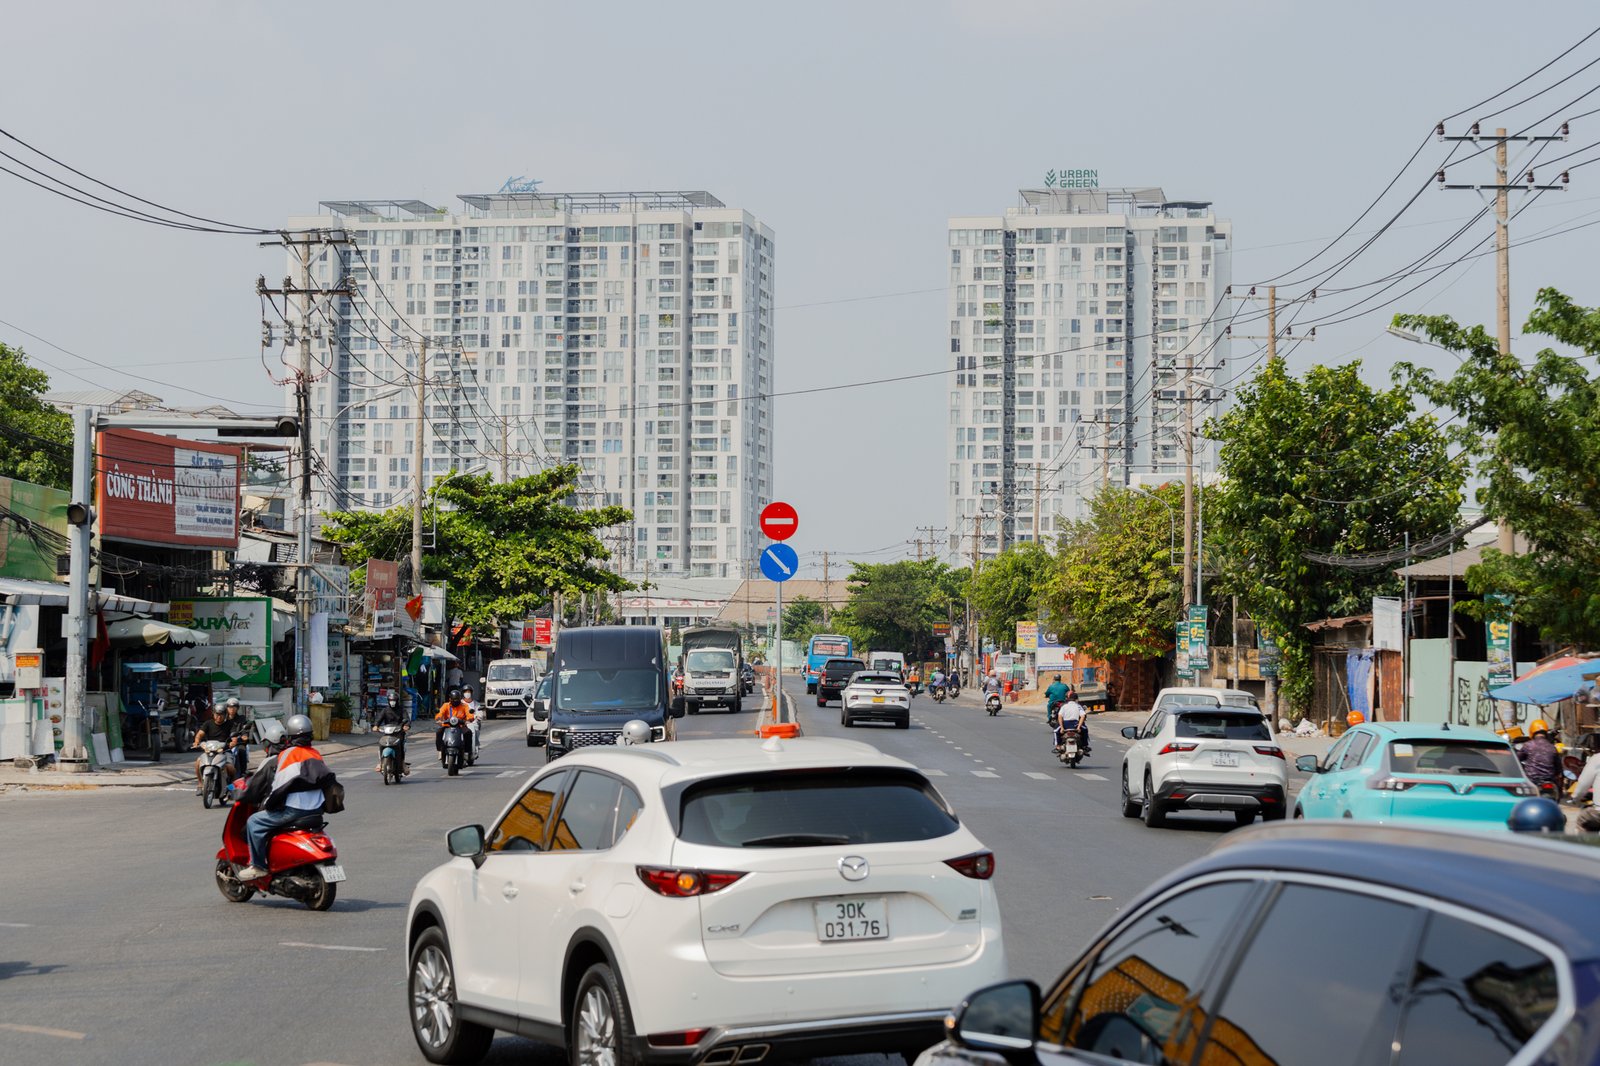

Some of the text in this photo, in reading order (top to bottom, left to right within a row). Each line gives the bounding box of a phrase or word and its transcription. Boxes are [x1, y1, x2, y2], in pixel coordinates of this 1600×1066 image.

[1060, 169, 1098, 179] URBAN
[1060, 179, 1099, 188] GREEN
[106, 464, 173, 504] CÔNG THÀNH
[837, 902, 866, 919] 30K
[826, 919, 880, 938] 031.76
